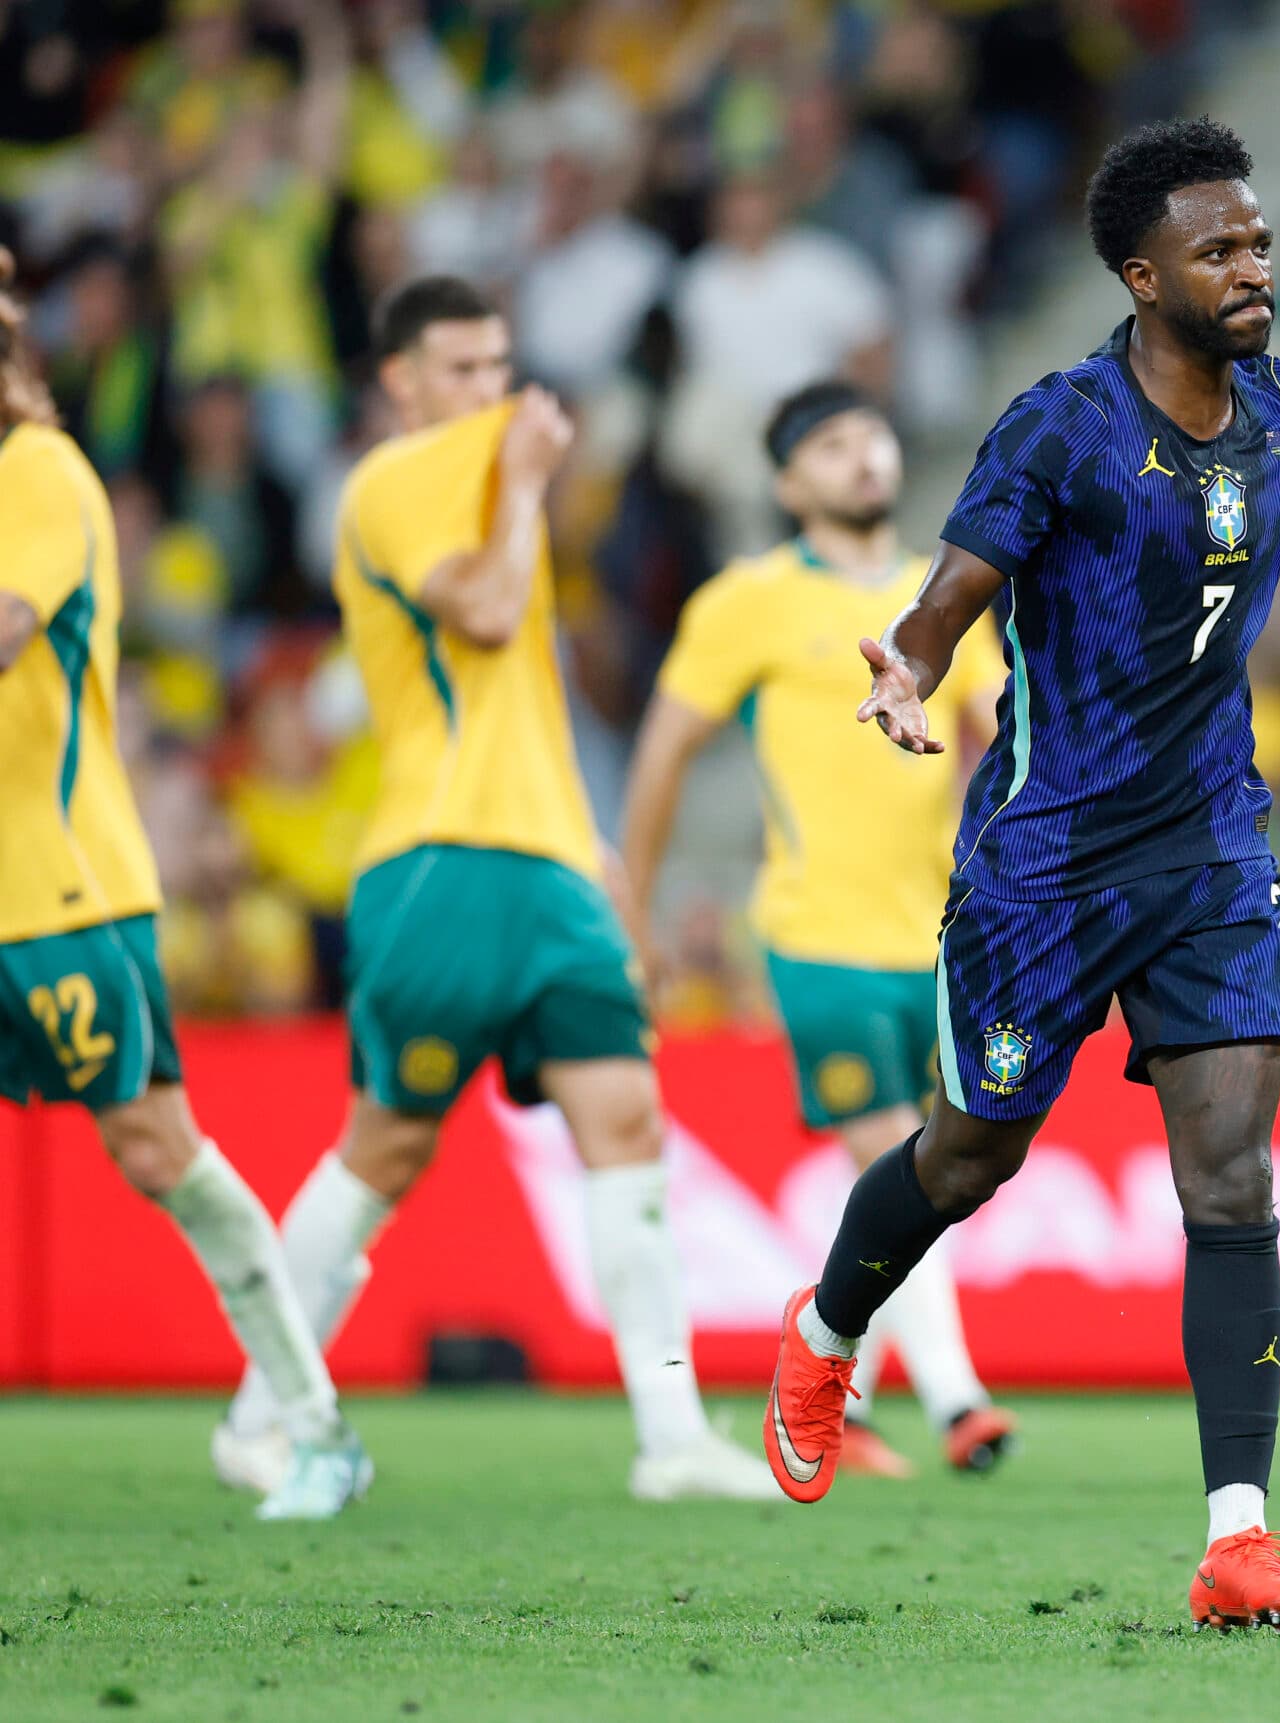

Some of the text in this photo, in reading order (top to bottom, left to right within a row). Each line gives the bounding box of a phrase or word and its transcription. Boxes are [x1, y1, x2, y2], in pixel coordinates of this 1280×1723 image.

[1217, 504, 1233, 514] CBF
[1204, 549, 1249, 566] BRASIL
[1189, 585, 1236, 664] 7
[27, 972, 116, 1091] 22
[997, 1051, 1014, 1060] CBF
